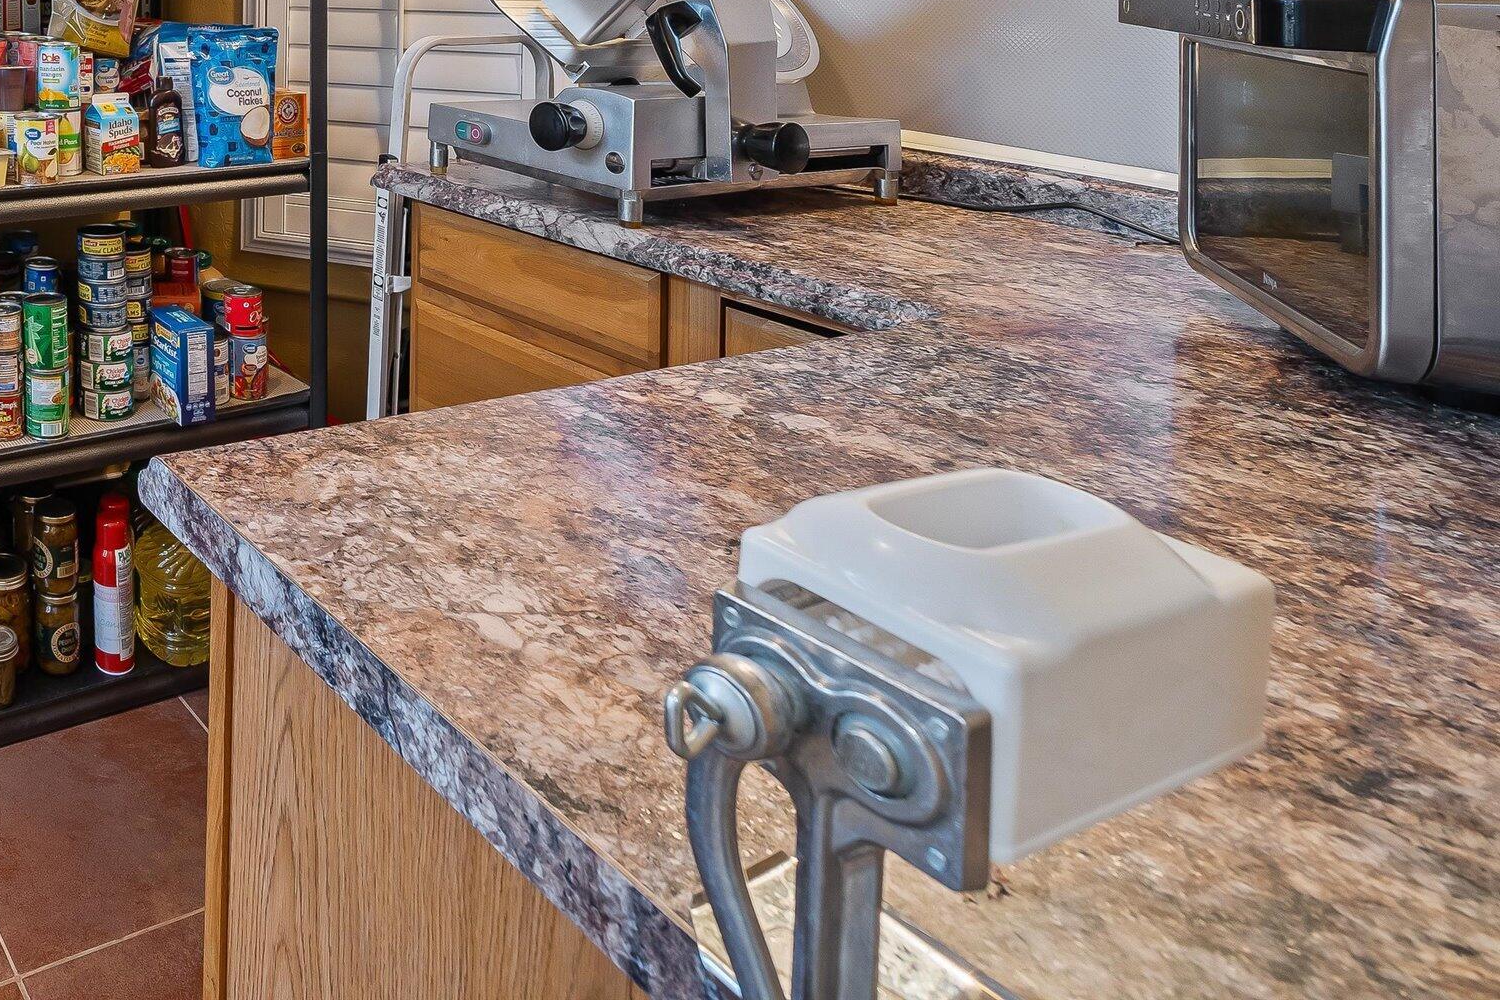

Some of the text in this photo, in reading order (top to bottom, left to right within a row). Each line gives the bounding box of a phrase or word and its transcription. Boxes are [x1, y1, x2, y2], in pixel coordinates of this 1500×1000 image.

[42, 53, 60, 61] Dole
[226, 89, 262, 98] Coconut
[238, 97, 263, 106] Flakes
[109, 118, 132, 130] Idaho
[108, 127, 133, 138] Spuds
